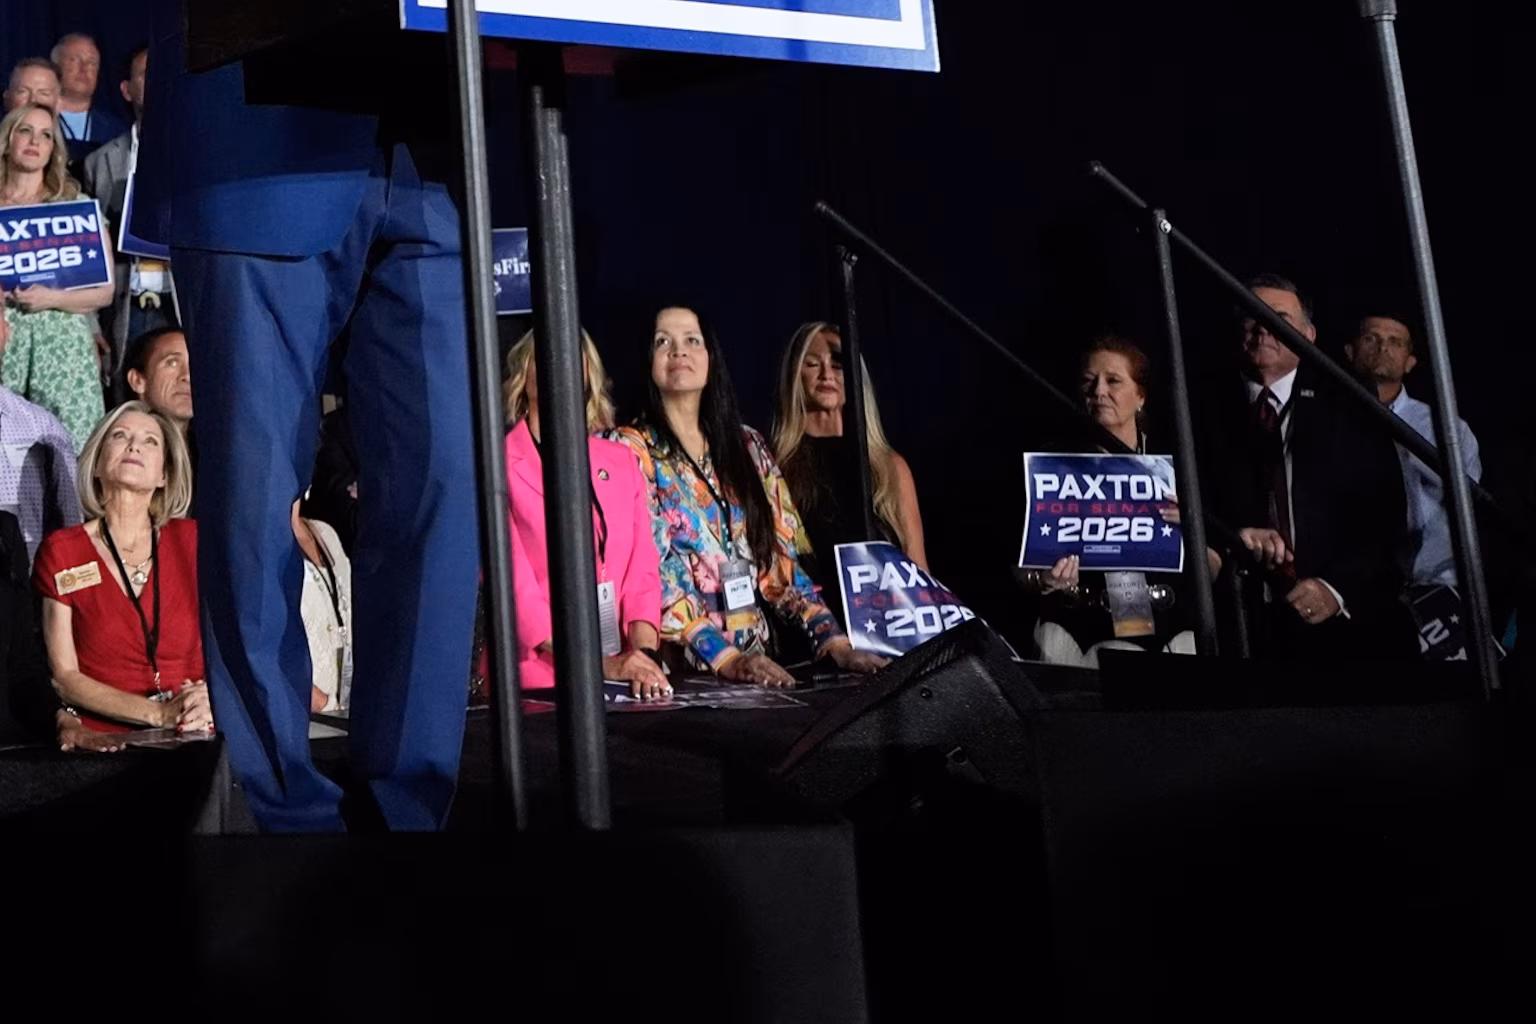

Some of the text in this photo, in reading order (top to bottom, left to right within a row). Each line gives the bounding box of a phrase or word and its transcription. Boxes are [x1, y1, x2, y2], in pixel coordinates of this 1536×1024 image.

[1033, 473, 1177, 501] PAXTON
[1036, 503, 1080, 514] FOR
[1057, 516, 1155, 543] 2026
